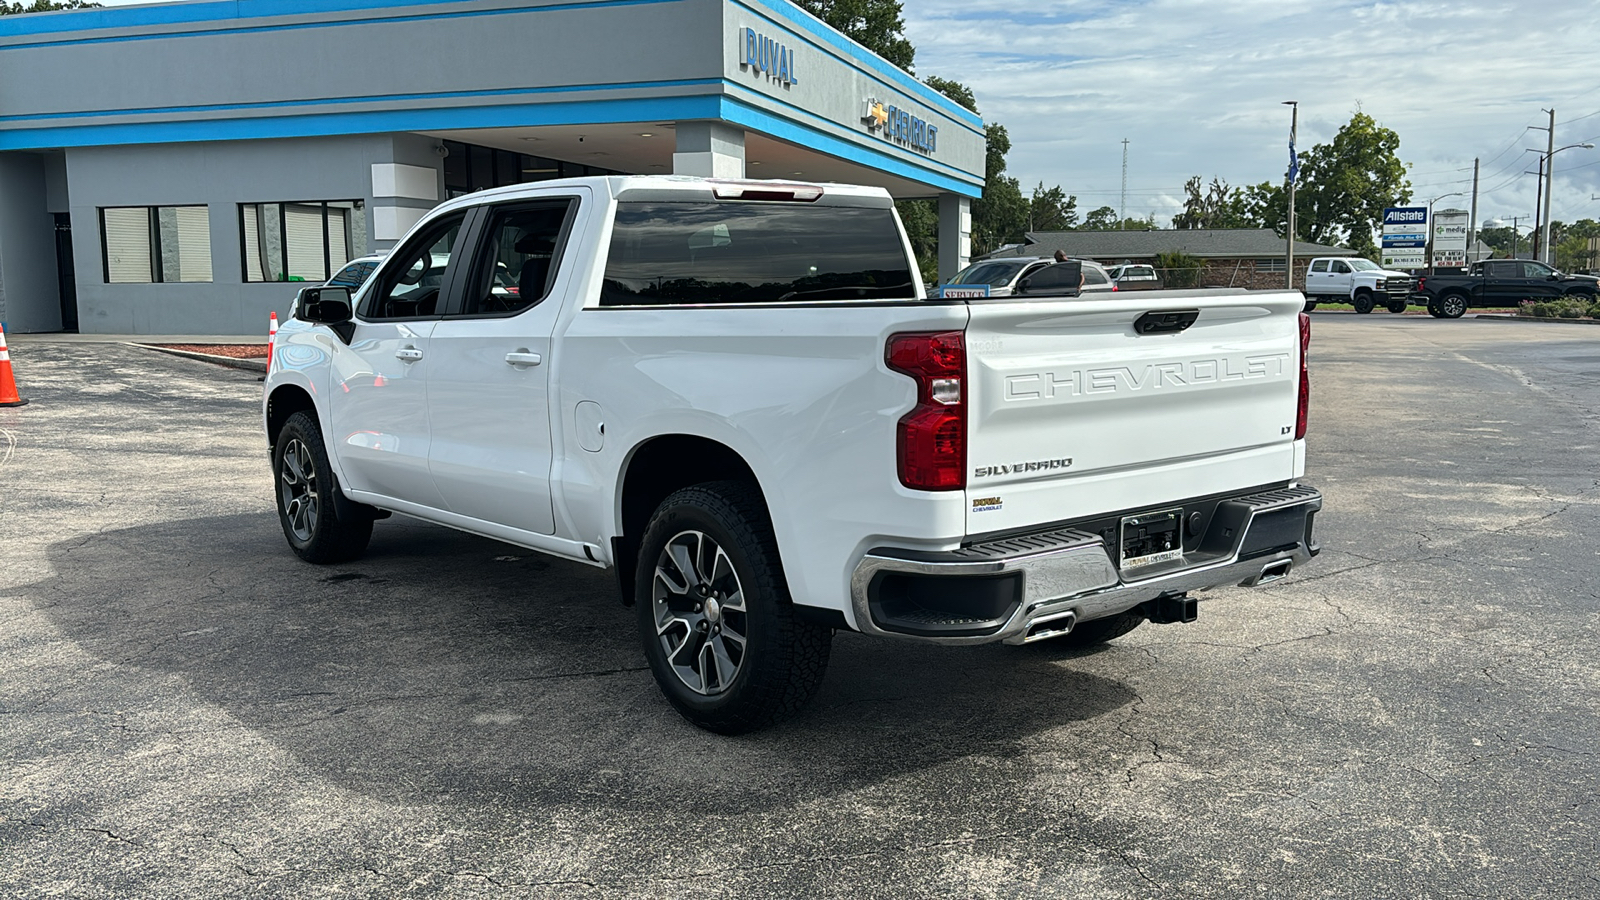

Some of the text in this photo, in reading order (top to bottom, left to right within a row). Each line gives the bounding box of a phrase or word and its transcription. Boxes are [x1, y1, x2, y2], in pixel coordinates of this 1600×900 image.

[741, 27, 797, 85] DUVAL
[888, 105, 938, 152] CHEVROLET
[1385, 211, 1424, 222] Allstate
[1004, 352, 1290, 402] CHEVROLET
[1281, 425, 1293, 435] LT
[974, 457, 1073, 478] SILVERADO
[973, 496, 1003, 507] DUVAL
